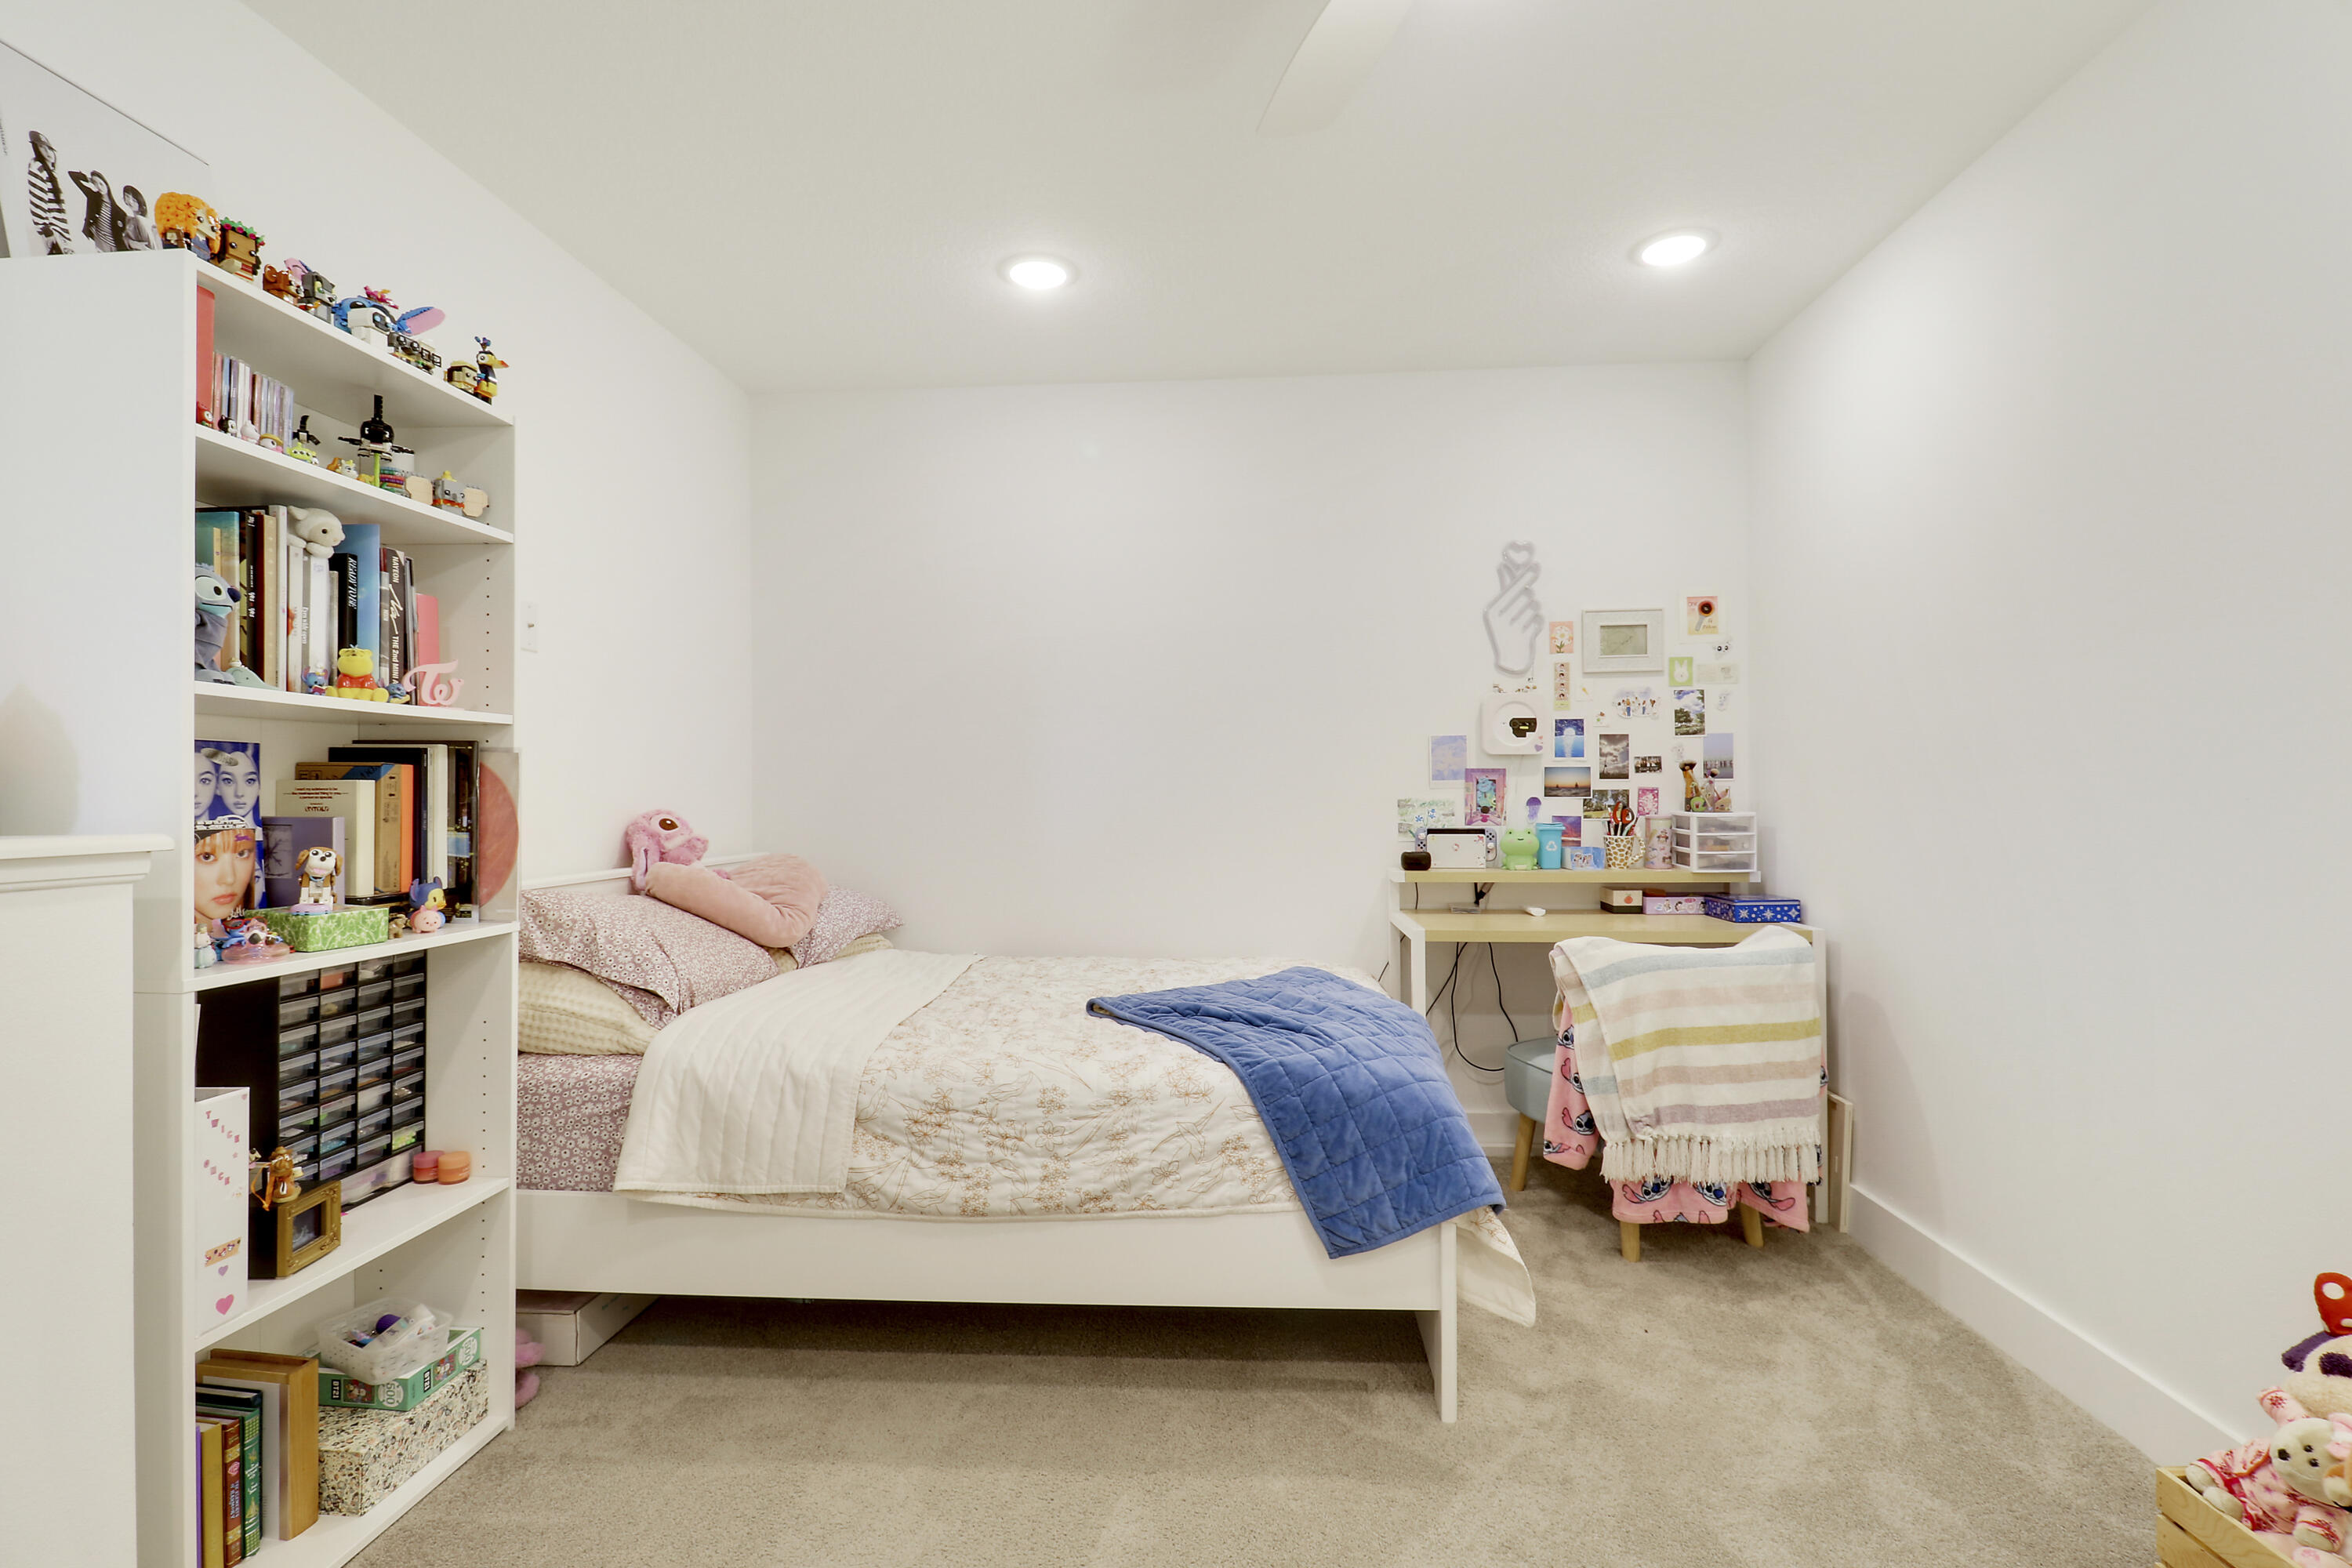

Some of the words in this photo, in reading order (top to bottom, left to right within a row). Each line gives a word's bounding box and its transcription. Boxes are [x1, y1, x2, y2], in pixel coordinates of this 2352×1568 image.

[348, 557, 357, 584] READY
[391, 556, 400, 583] NAYEON
[386, 1382, 396, 1405] 500
